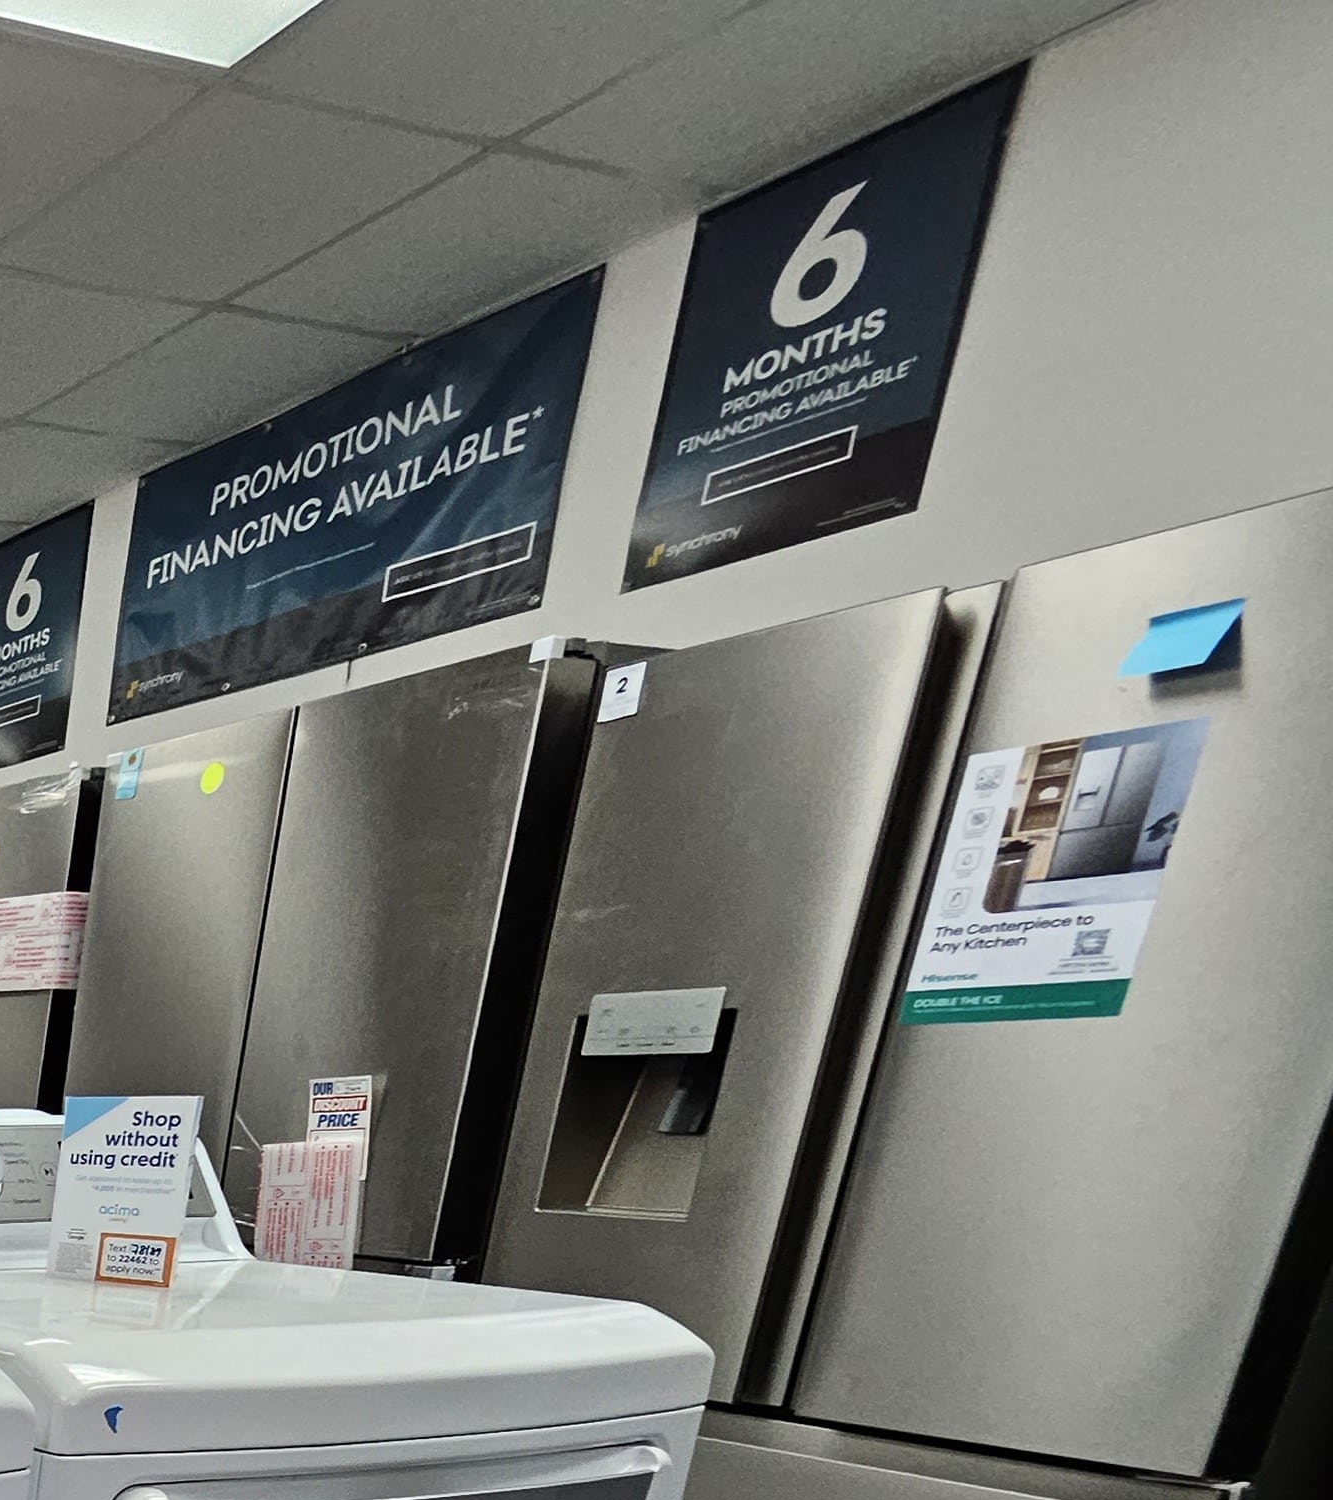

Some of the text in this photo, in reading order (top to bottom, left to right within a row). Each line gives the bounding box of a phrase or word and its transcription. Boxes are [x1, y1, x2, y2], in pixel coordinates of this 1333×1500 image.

[770, 179, 869, 328] 6
[722, 307, 888, 394] MONTHS
[720, 350, 876, 419] PROMOTIONAL
[677, 402, 793, 456] FINANCING
[210, 384, 463, 516] PROMOTIONAL
[146, 497, 323, 589] FINANCING
[664, 524, 742, 558] synchrony
[5, 551, 42, 632] 6
[616, 677, 628, 694] 2
[935, 914, 1095, 938] The Centerpiece to
[930, 935, 1028, 955] Any Kitchen
[921, 972, 978, 984] Hisense
[313, 1082, 334, 1096] OUR
[132, 1110, 181, 1130] Shop
[317, 1113, 360, 1128] PRICE
[105, 1131, 179, 1148] without
[70, 1150, 176, 1169] using credit
[99, 1204, 140, 1216] acima
[109, 1243, 127, 1252] Text
[105, 1264, 132, 1274] apply
[107, 1254, 160, 1265] to 22462 to
